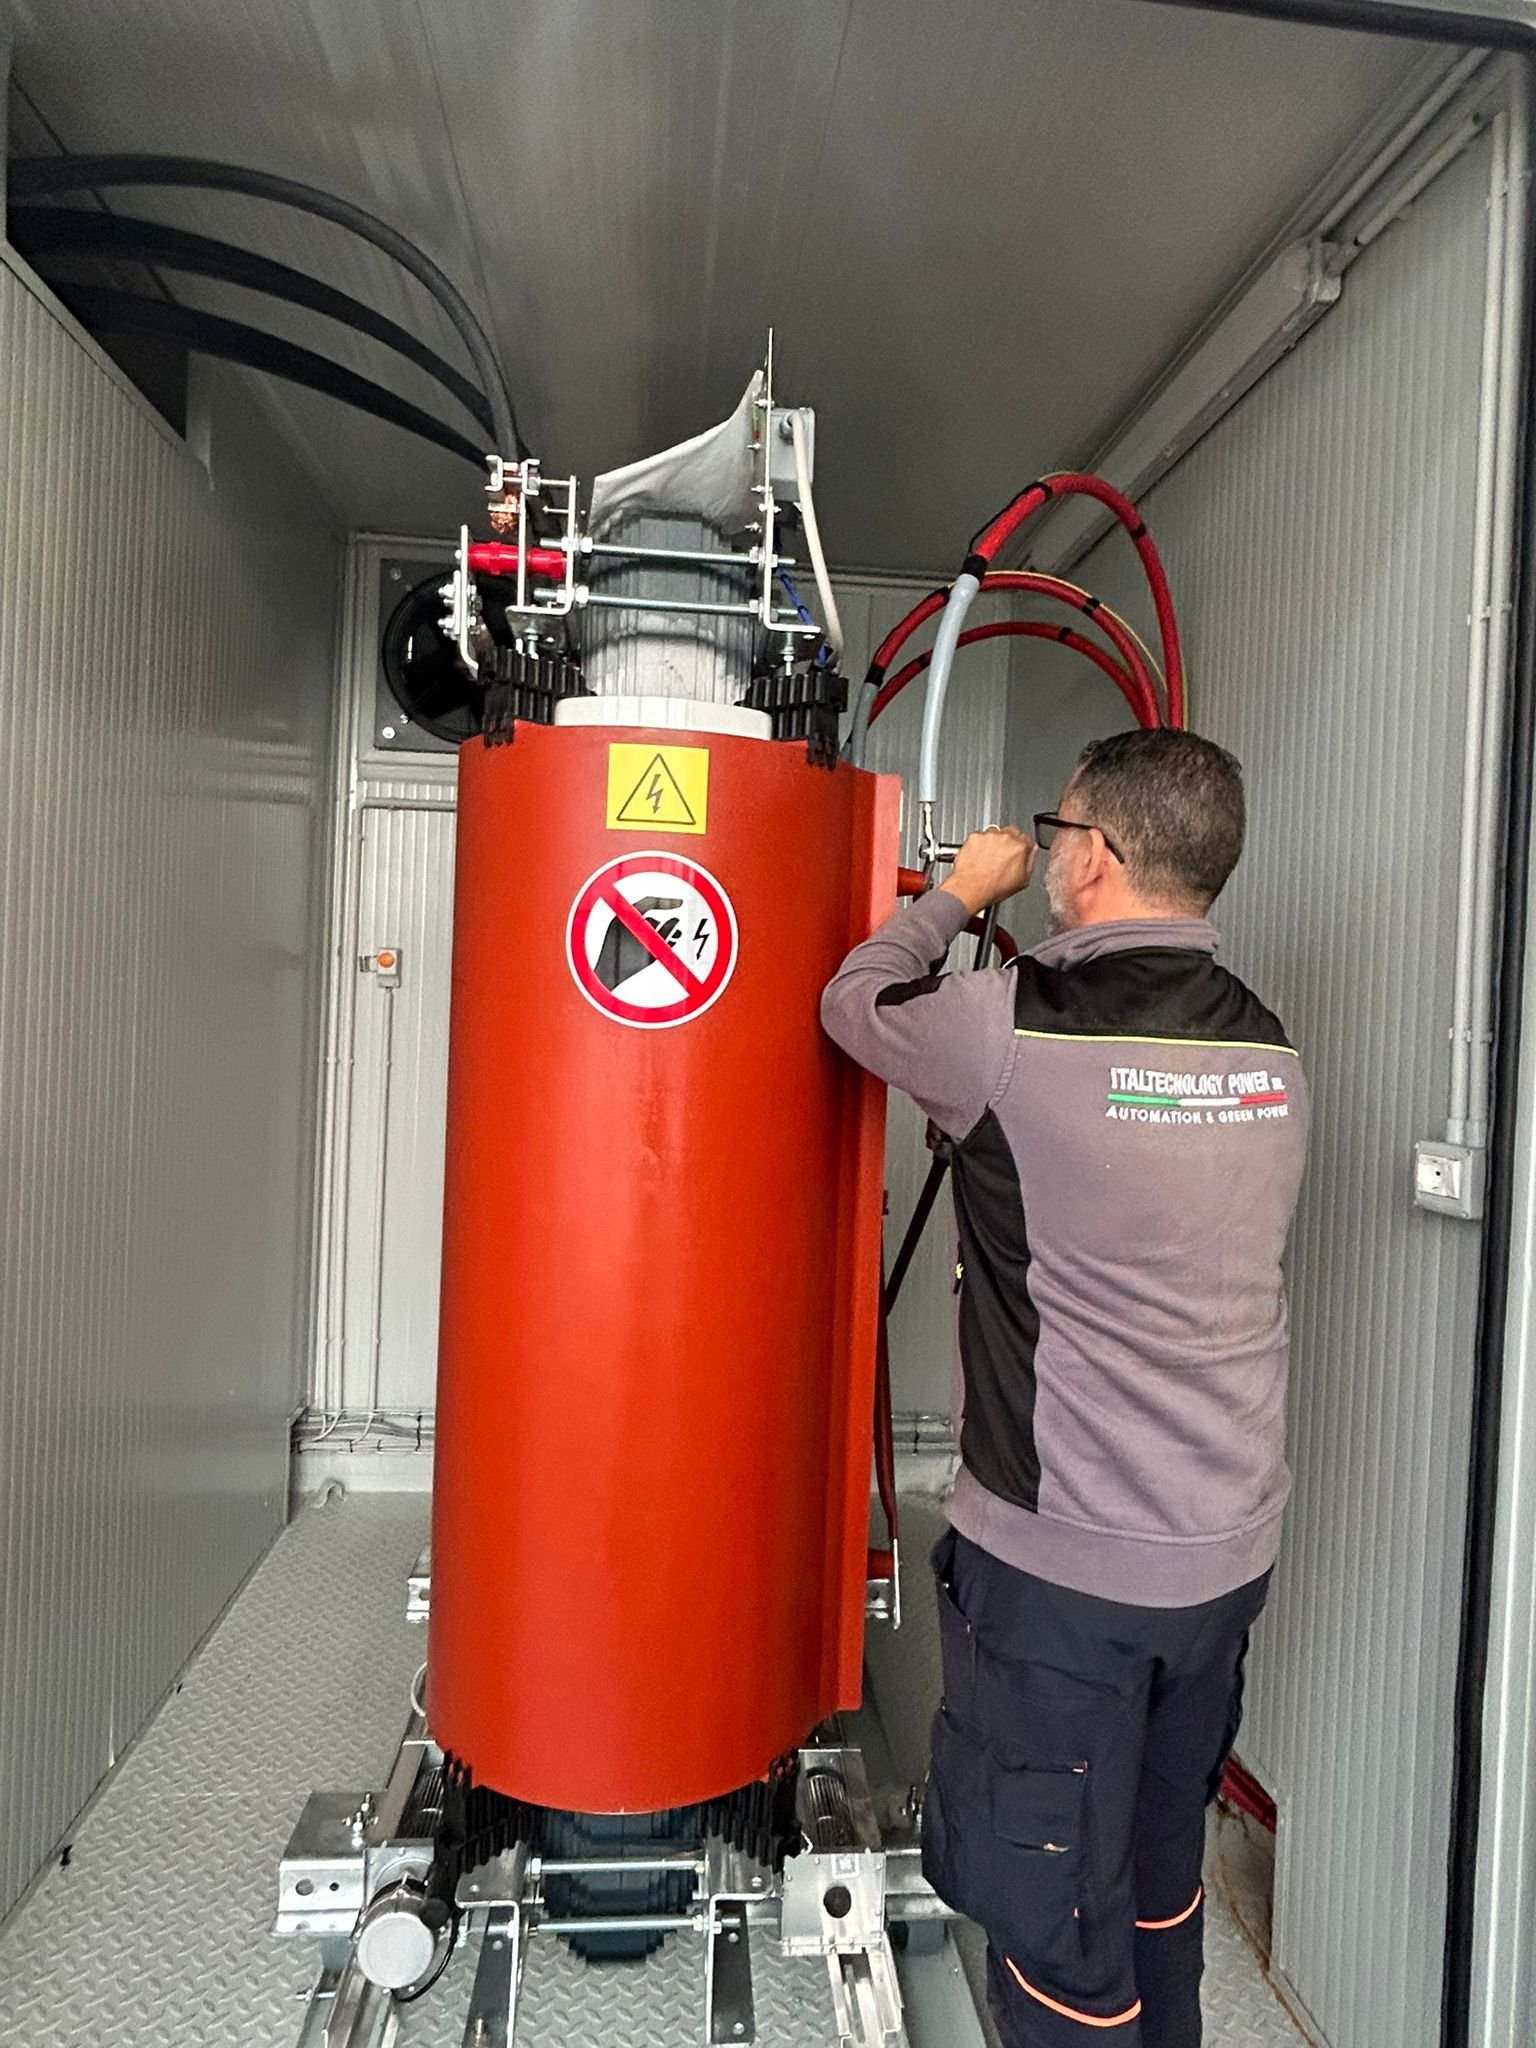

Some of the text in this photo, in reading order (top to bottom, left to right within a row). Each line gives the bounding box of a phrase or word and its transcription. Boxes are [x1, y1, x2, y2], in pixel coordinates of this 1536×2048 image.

[1228, 1070, 1270, 1095] POWER
[1105, 1104, 1289, 1124] AUTOMATION & GREEN POWER
